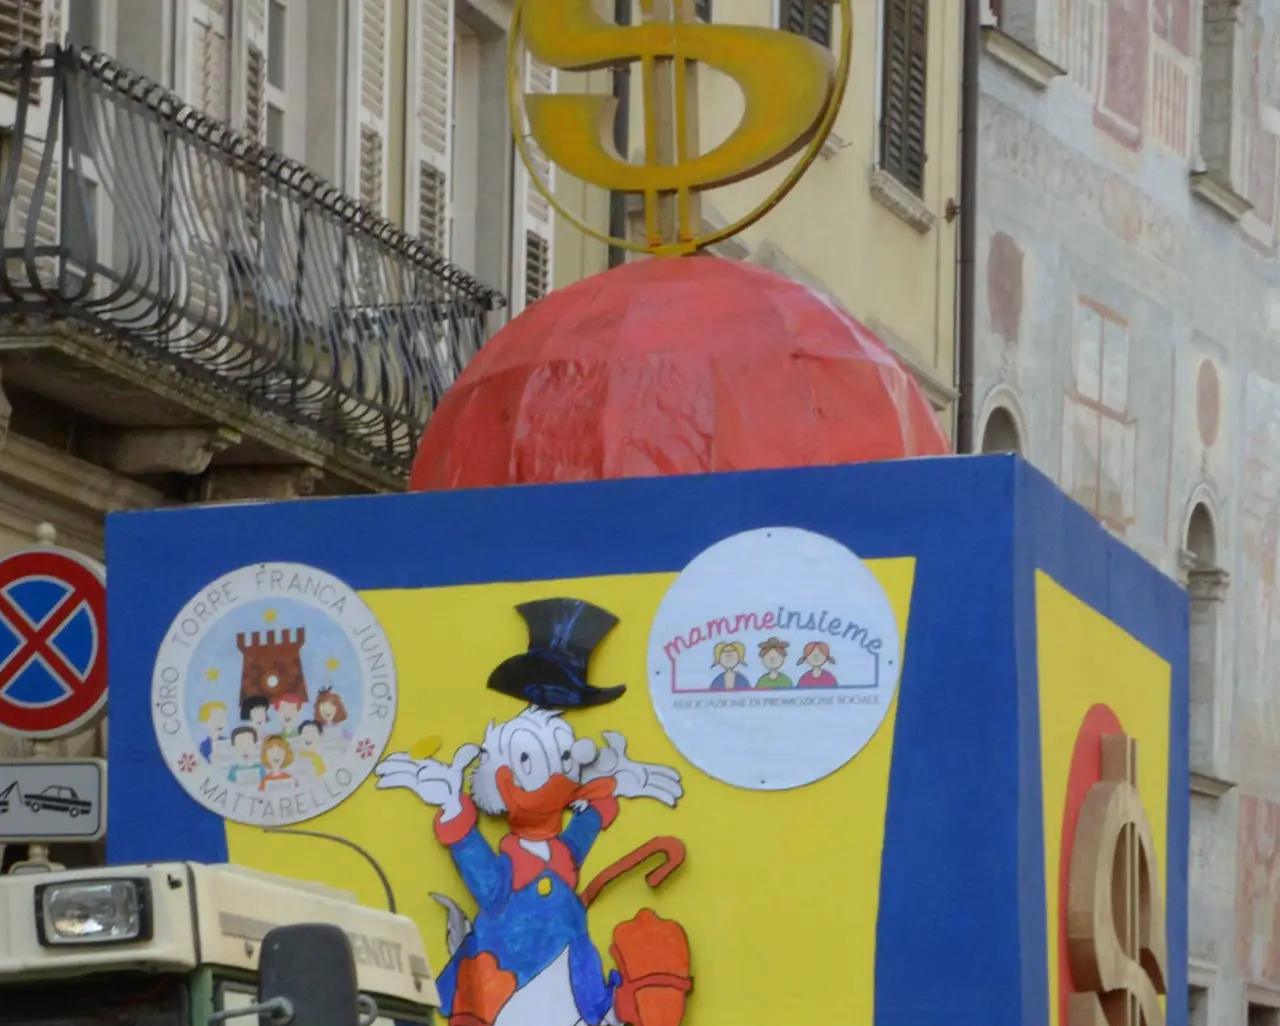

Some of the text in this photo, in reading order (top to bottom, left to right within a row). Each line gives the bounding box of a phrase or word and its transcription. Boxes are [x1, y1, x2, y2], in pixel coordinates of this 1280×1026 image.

[159, 569, 389, 736] CORO TORRE FRANCA JUNIOR
[198, 777, 353, 820] MATTARELLO
[348, 931, 405, 974] ENDT
